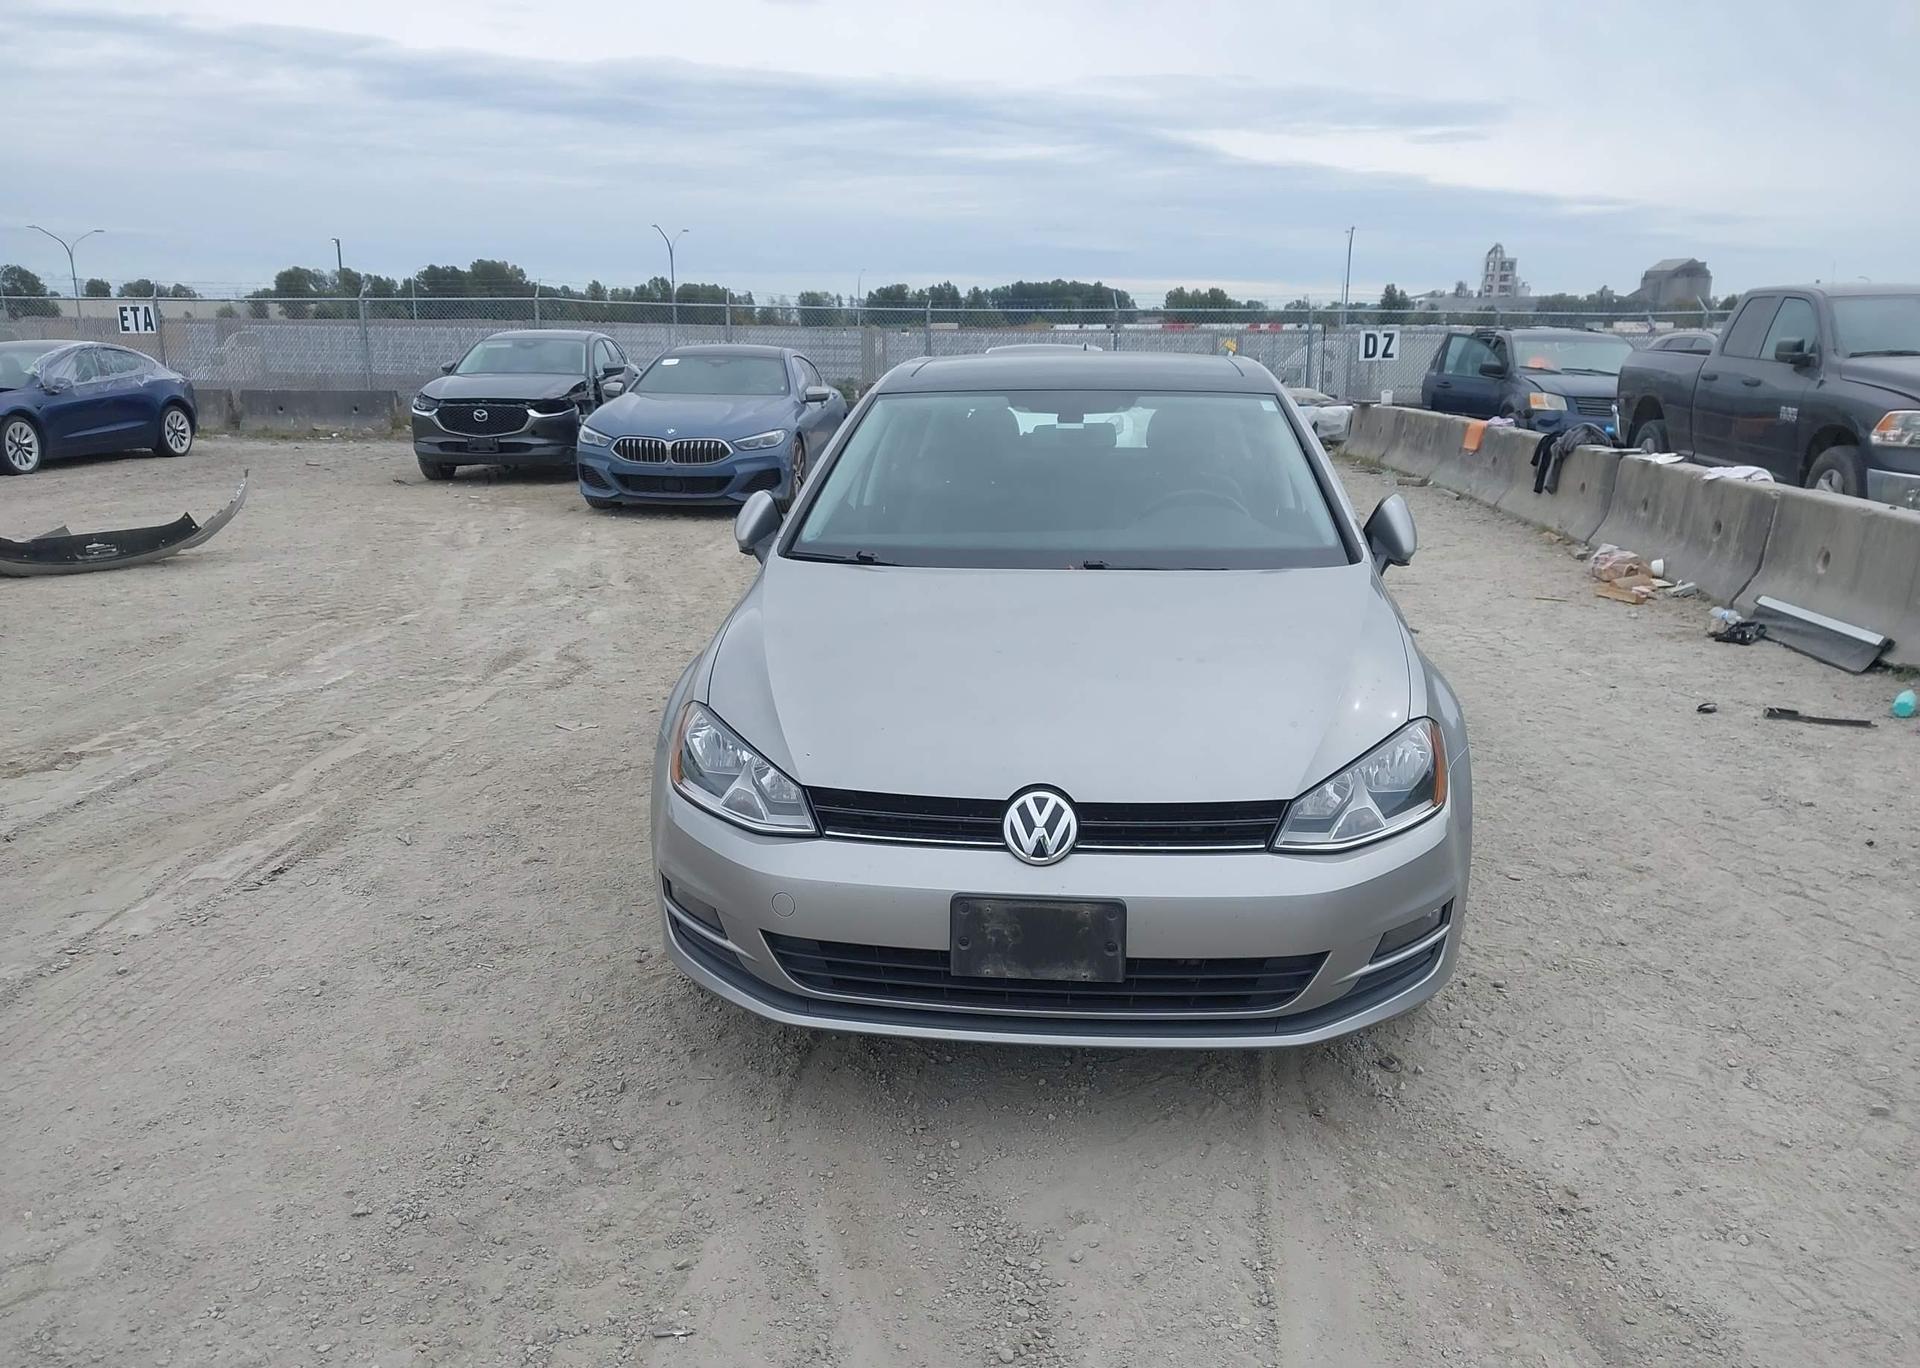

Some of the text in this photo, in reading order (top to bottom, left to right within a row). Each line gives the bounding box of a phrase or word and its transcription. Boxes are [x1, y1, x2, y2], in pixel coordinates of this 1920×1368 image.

[118, 306, 155, 332] ETA
[1363, 332, 1395, 359] DZ
[1006, 793, 1074, 860] VW
